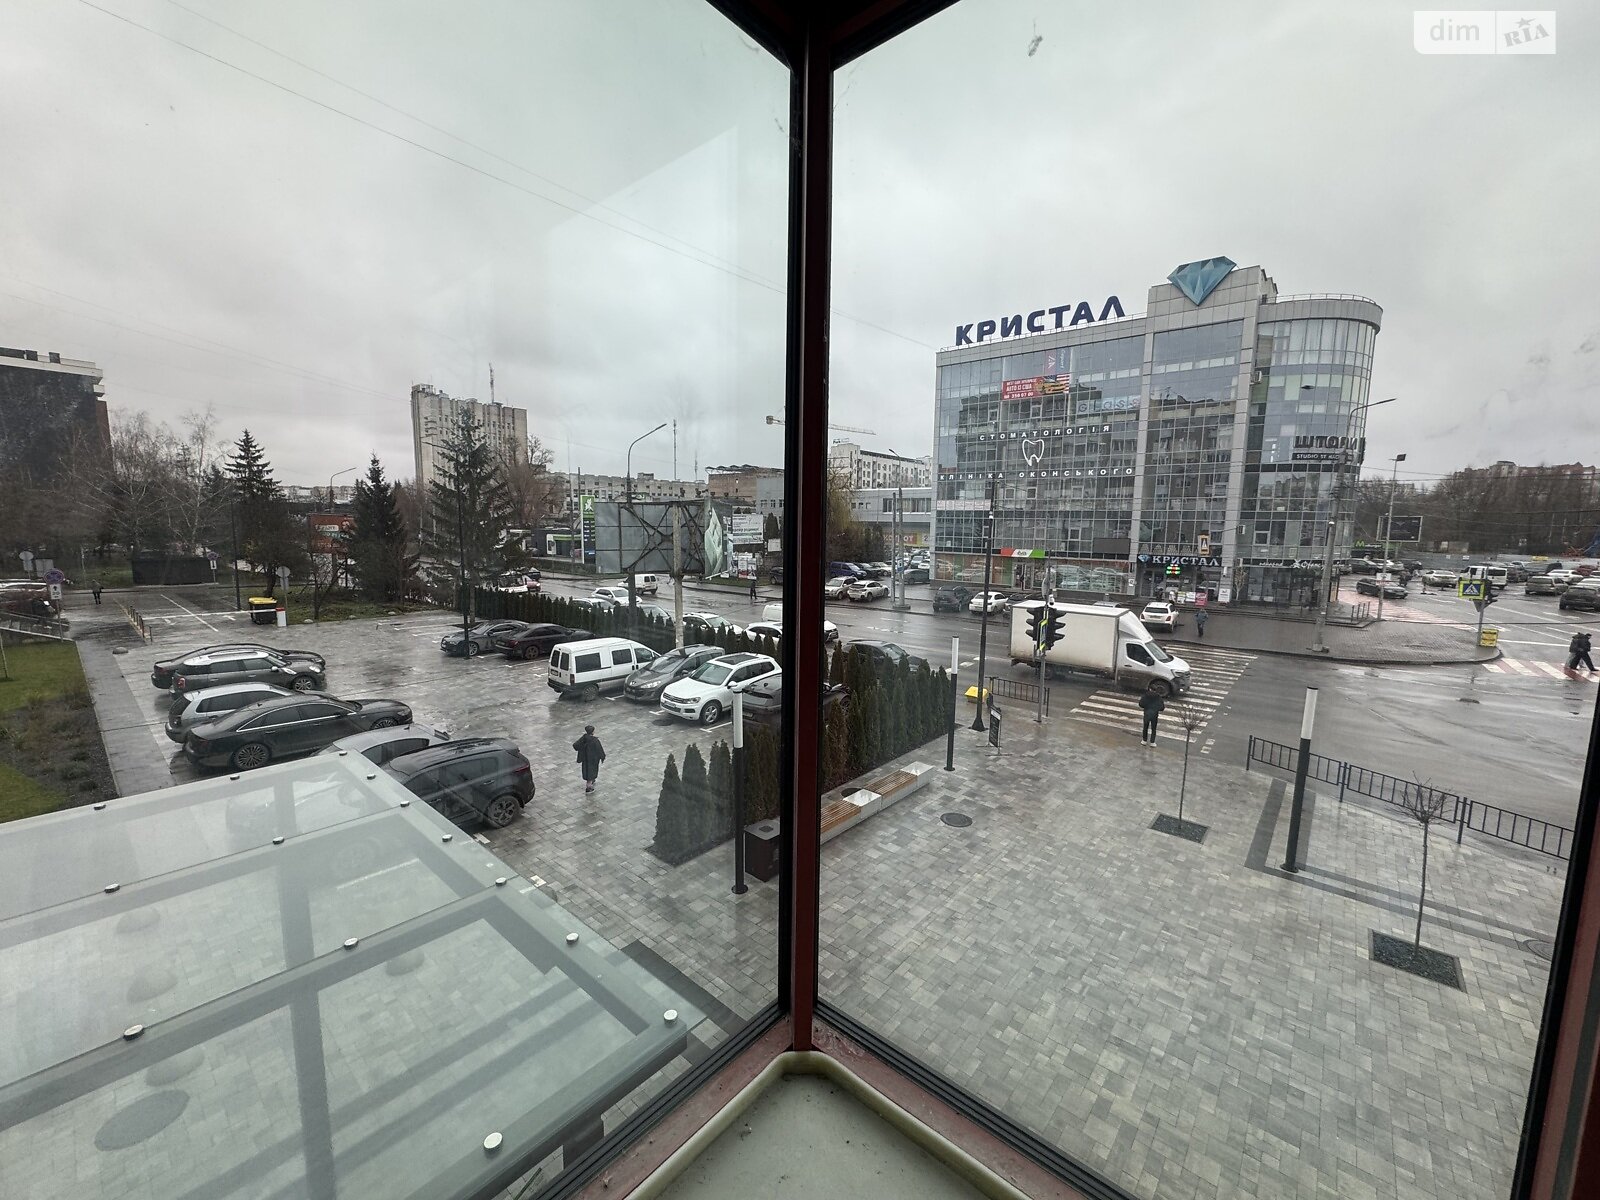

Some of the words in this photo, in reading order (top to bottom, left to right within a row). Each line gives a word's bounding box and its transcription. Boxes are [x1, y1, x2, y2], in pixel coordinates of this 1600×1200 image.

[955, 295, 1126, 346] КРИСТАЛ
[979, 425, 1110, 441] СТОМАТОЛОГІЯ
[940, 472, 1004, 480] КЛІНІКА
[1018, 468, 1133, 479] ОКОНСЬКОГО
[1152, 555, 1219, 566] КРИСТАЛ
